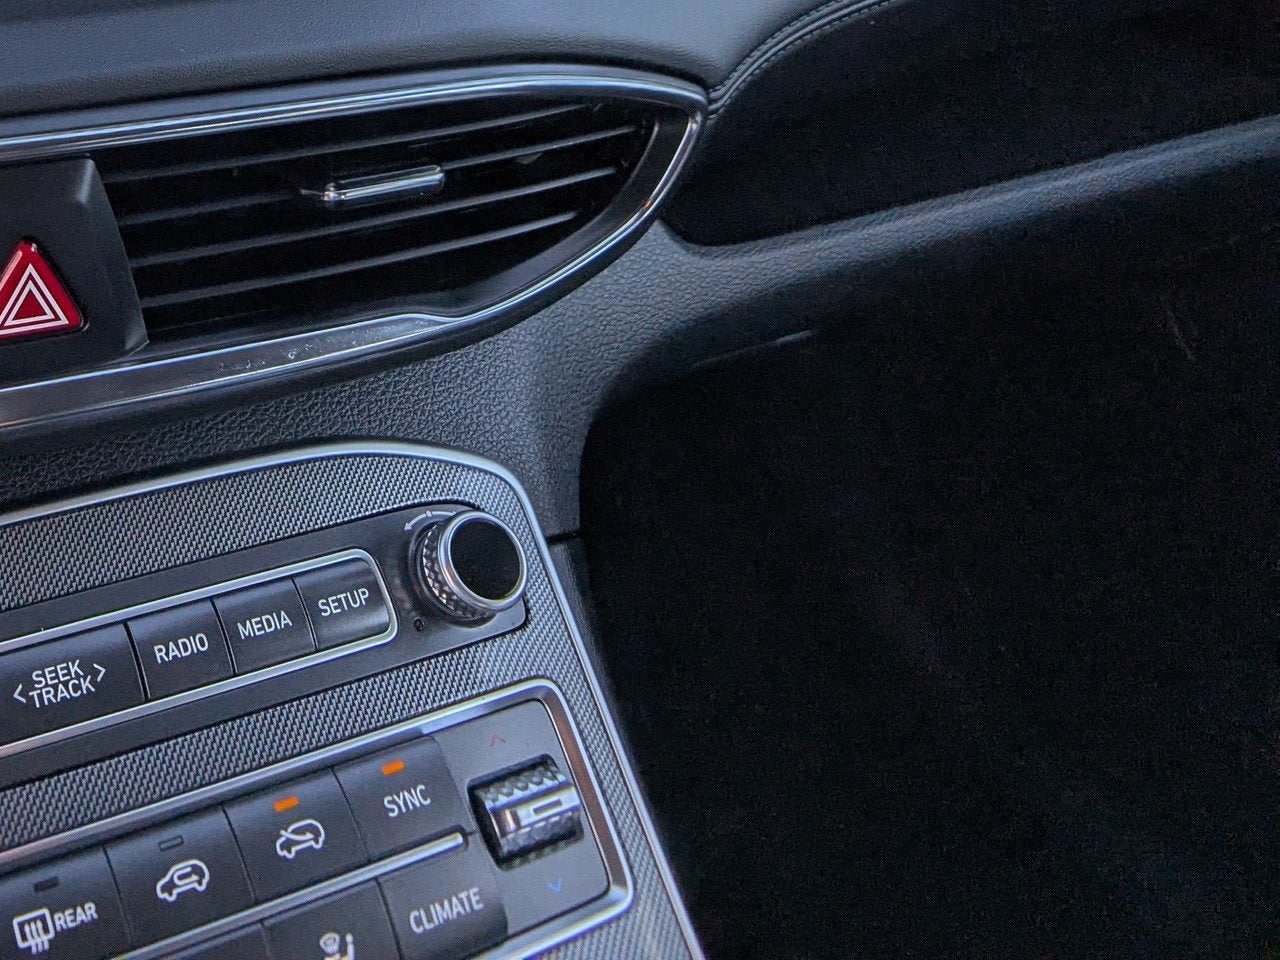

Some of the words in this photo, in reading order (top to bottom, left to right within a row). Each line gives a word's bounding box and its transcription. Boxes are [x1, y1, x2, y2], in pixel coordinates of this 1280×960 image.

[317, 587, 370, 618] SETUP
[237, 610, 293, 640] MEDIA
[153, 633, 209, 665] RADIO
[31, 659, 85, 689] SEEK
[28, 675, 96, 709] TRACK
[383, 784, 431, 819] SYNC
[54, 902, 99, 932] REAR
[409, 887, 484, 931] CLIMATE
